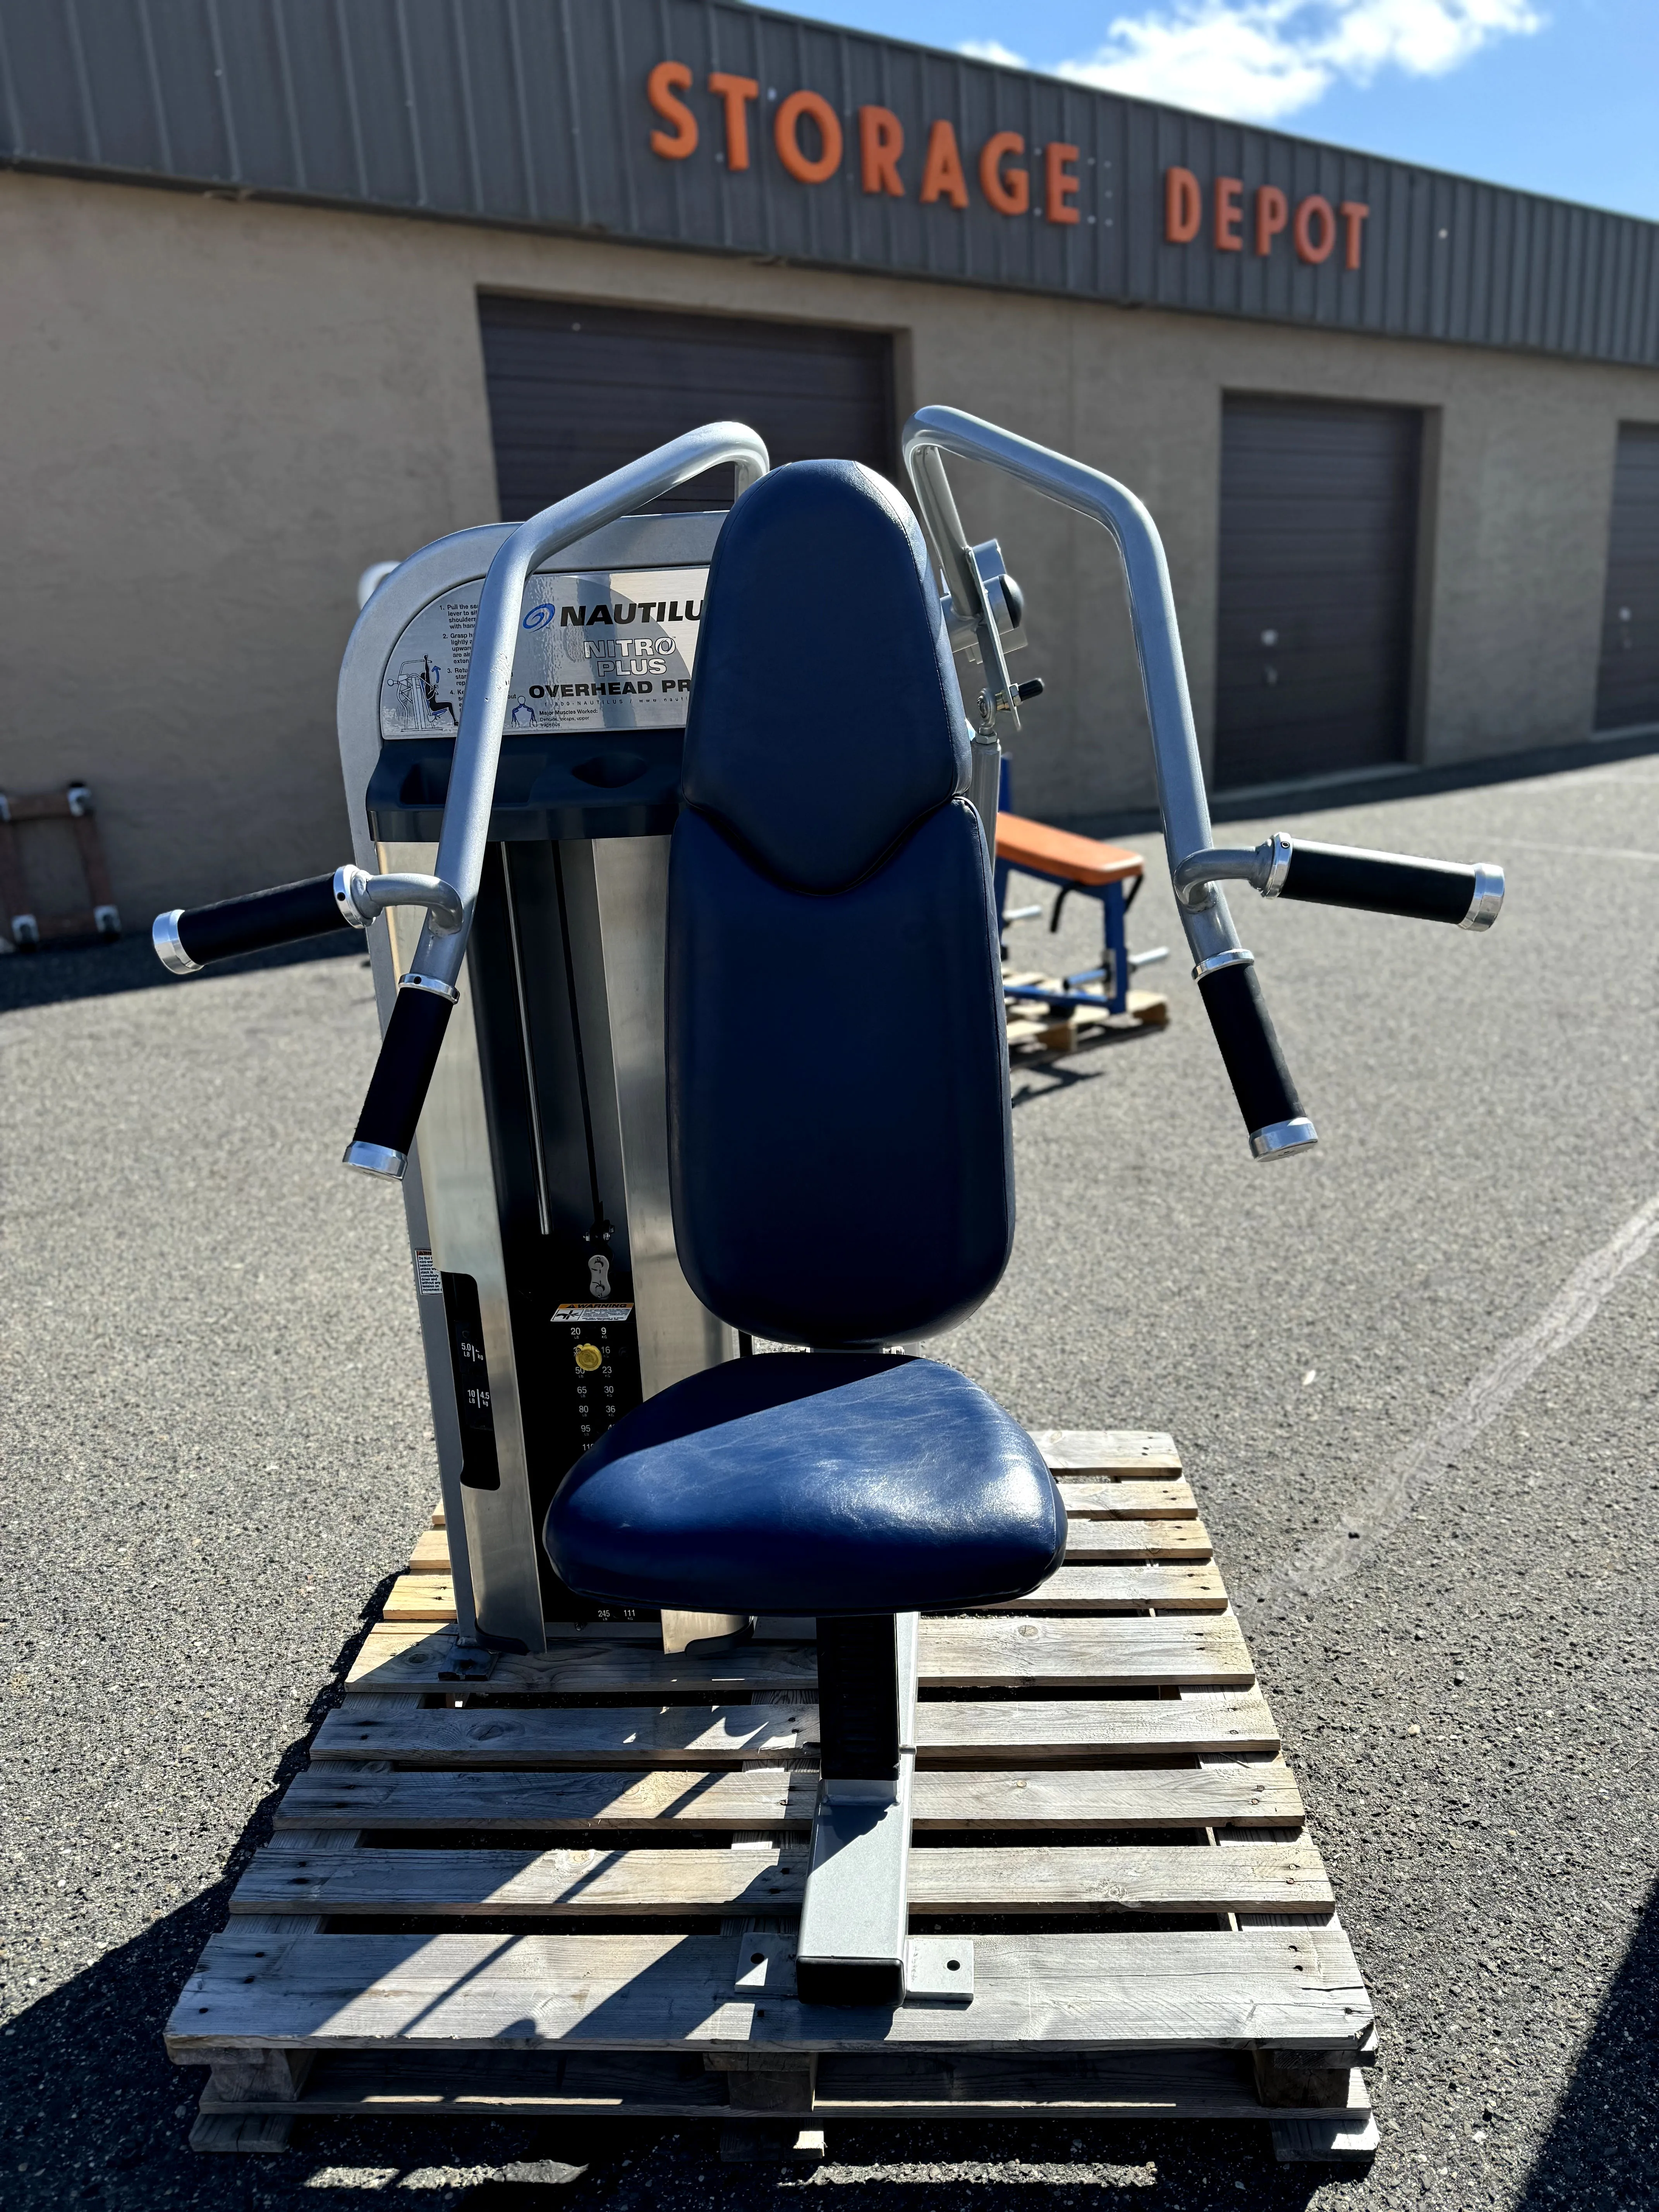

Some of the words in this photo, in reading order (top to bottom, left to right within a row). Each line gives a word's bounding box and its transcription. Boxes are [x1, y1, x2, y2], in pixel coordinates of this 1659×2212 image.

[647, 61, 1080, 225] STORAGE
[1166, 167, 1370, 270] DEPOT
[560, 599, 704, 627] NAUTILU
[584, 636, 676, 658] NITRO
[597, 658, 667, 677] PLUS
[529, 680, 653, 699] OVERHEAD
[661, 678, 691, 693] PR
[570, 1327, 581, 1335] 20
[601, 1327, 607, 1335] 9
[461, 1343, 471, 1351] 5.0
[601, 1346, 611, 1354] 16
[602, 1366, 612, 1374] 23
[467, 1389, 476, 1398] 10
[480, 1391, 490, 1400] 4.5
